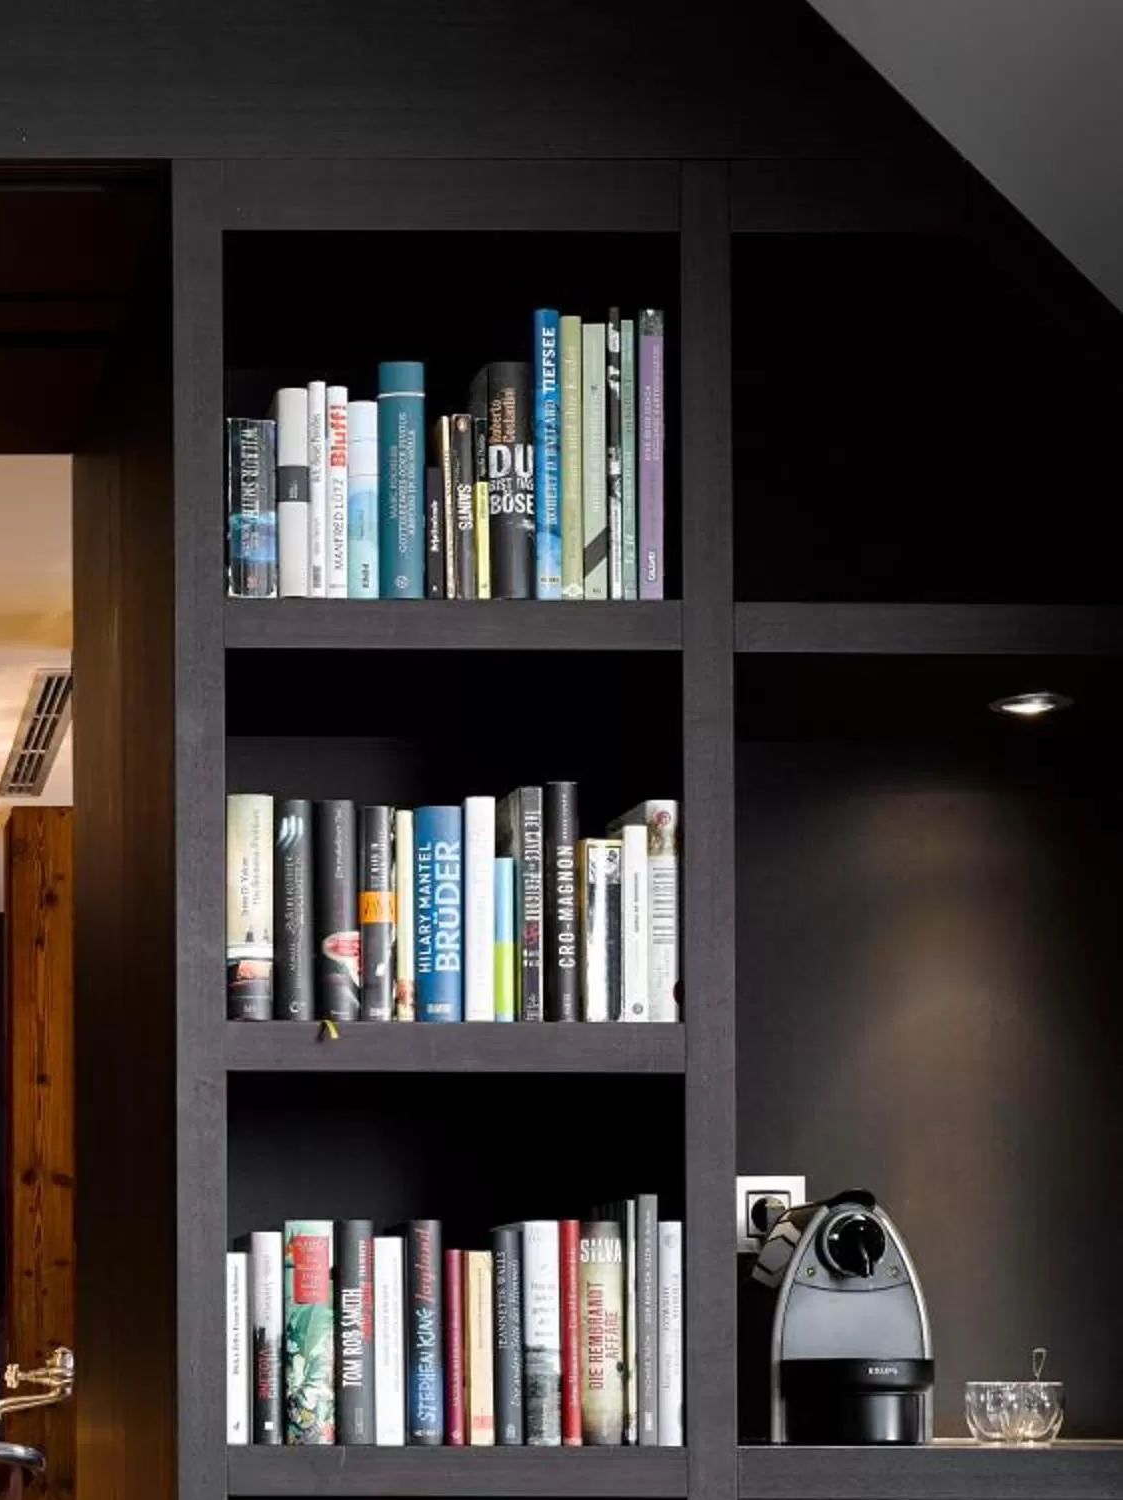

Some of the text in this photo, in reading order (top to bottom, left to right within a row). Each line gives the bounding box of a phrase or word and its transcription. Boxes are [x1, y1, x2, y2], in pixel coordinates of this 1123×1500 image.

[542, 327, 556, 395] TIEFSEE
[329, 404, 346, 468] Bluff!
[488, 444, 534, 478] DU
[332, 512, 344, 570] MANFRED
[457, 484, 473, 530] SAINTS
[418, 842, 432, 972] HILARY MANTEL
[432, 841, 460, 971] BRÜDER
[557, 844, 576, 969] CRO-MAGNON
[580, 1238, 622, 1262] SILVA
[341, 1288, 364, 1387] TOM ROB SMITH
[416, 1308, 437, 1422] STEPHEN KING
[586, 1280, 604, 1390] DIE REMBRANDT
